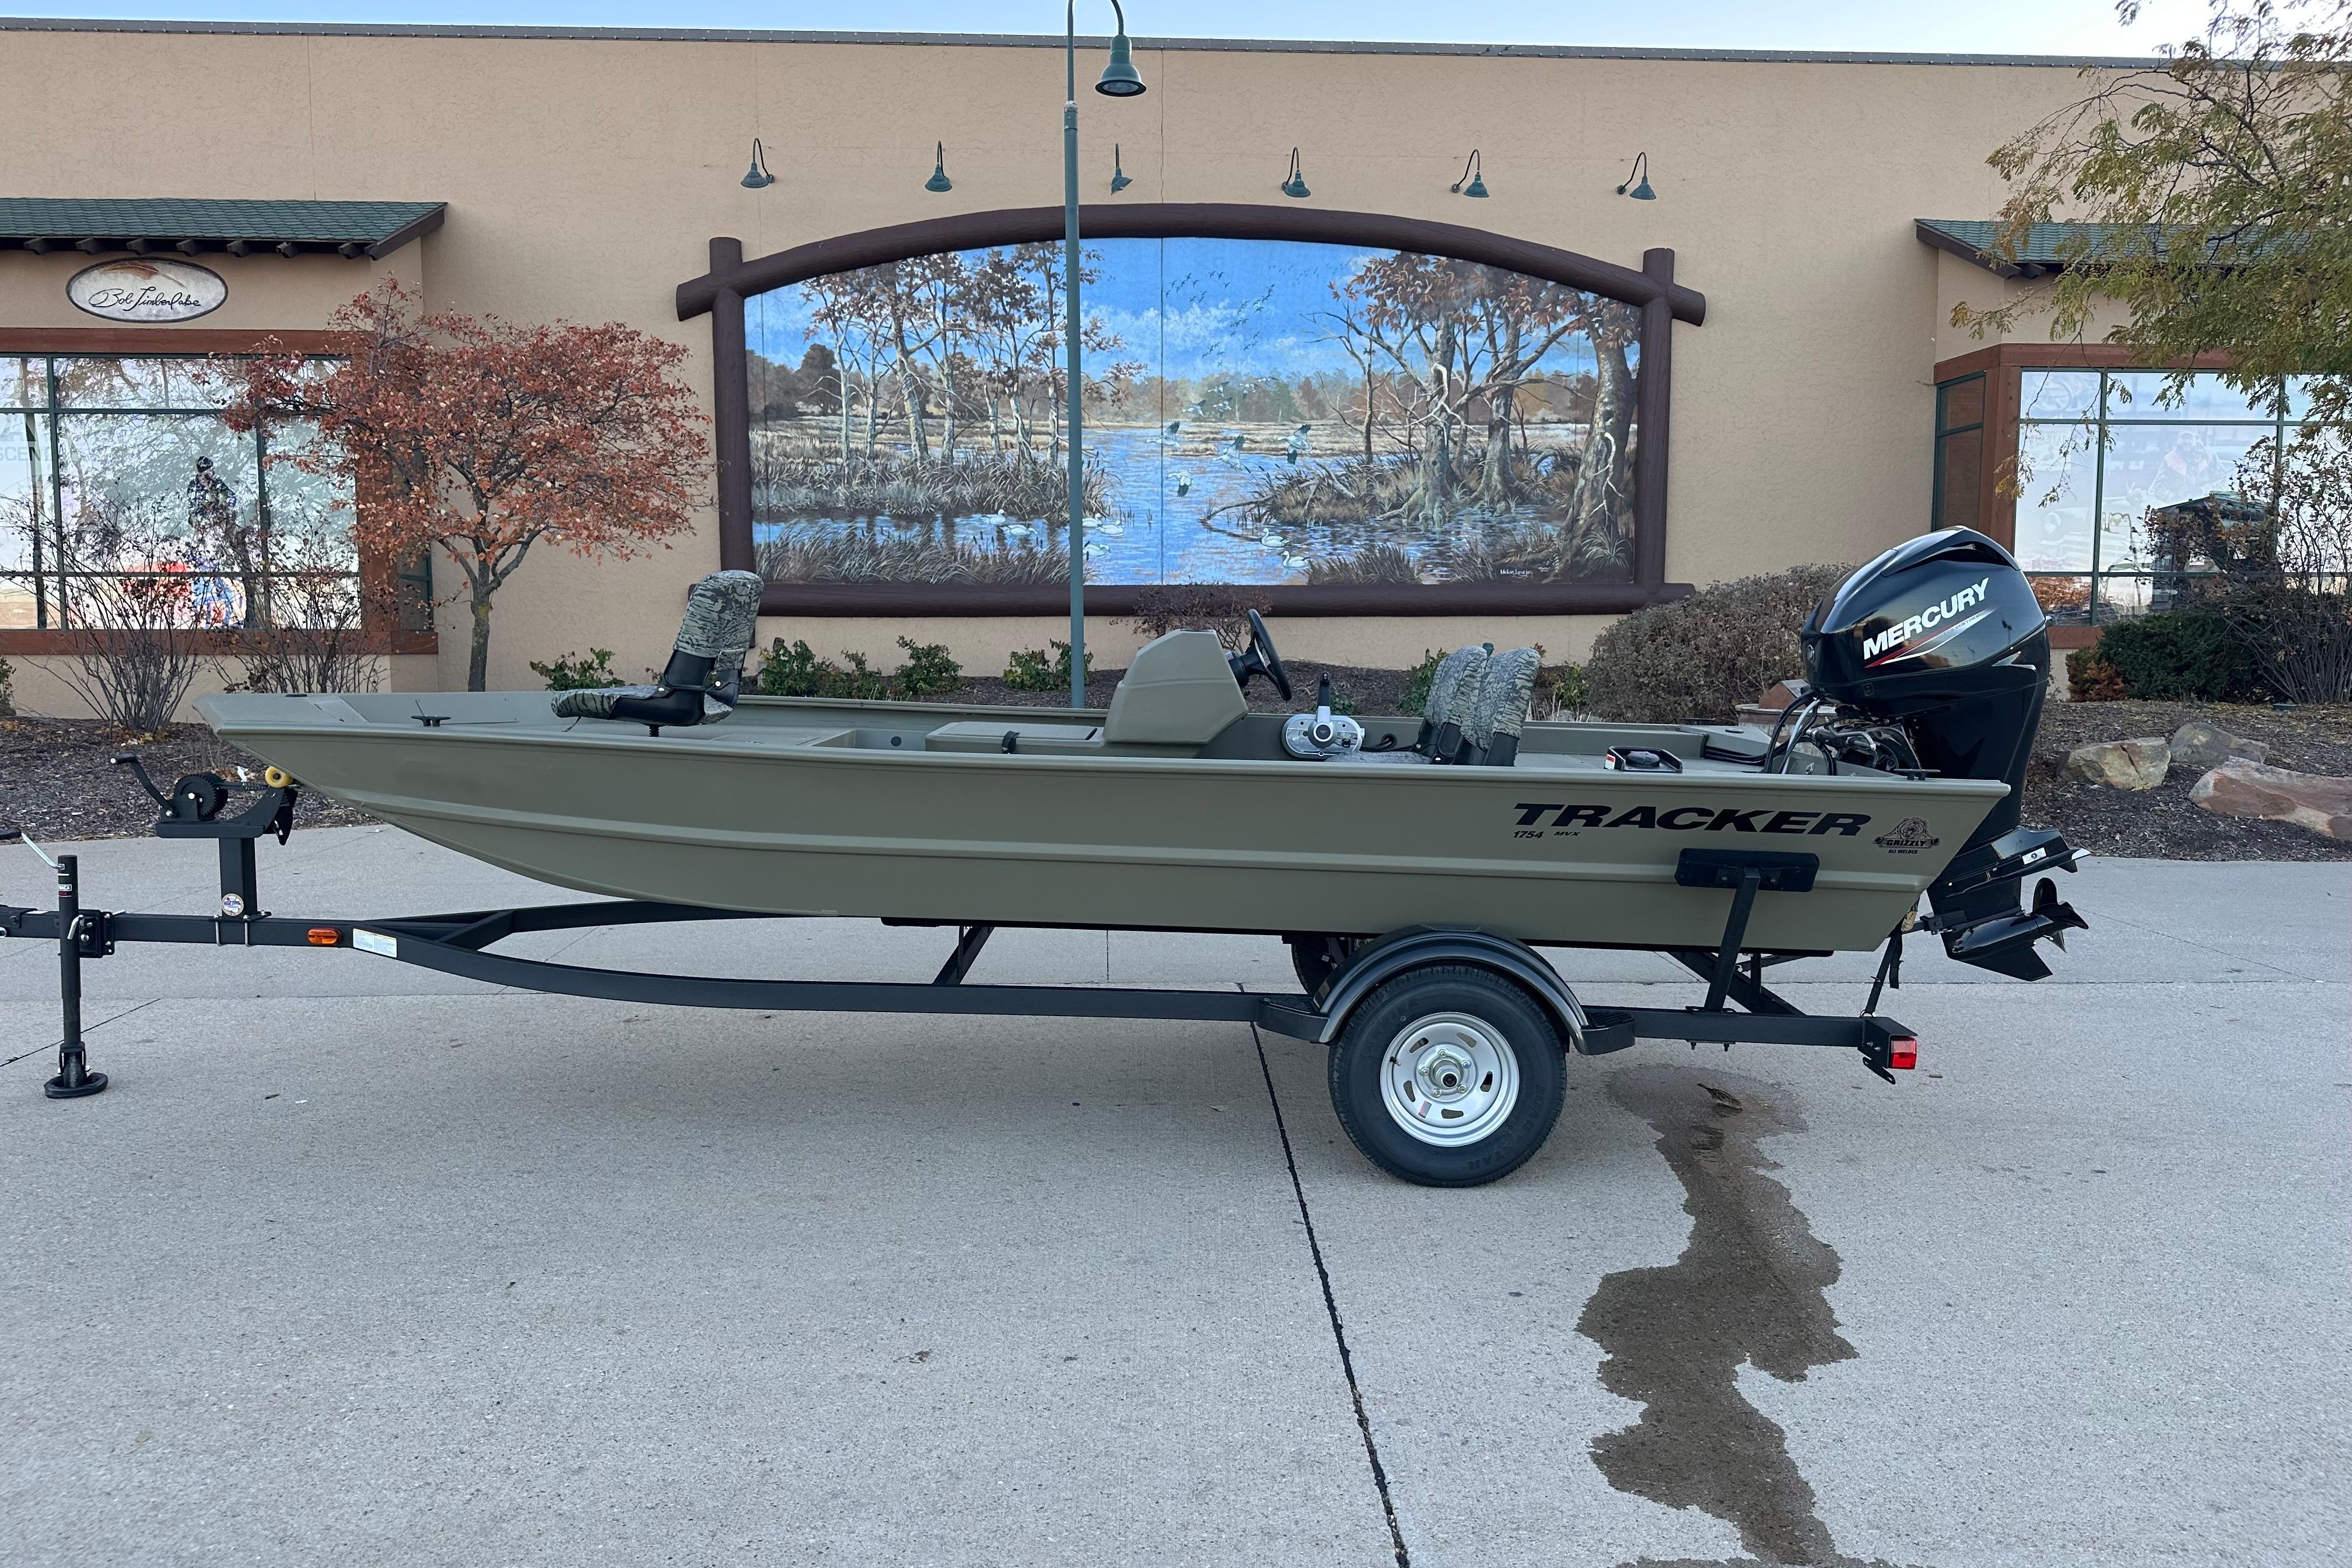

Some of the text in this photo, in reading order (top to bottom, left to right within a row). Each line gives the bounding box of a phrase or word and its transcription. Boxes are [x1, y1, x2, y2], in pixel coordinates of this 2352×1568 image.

[89, 286, 201, 312] Bob Timberlake
[1863, 577, 1989, 660] MERCURY
[1513, 803, 1872, 836] TRACKER
[1513, 830, 1544, 839] 1754
